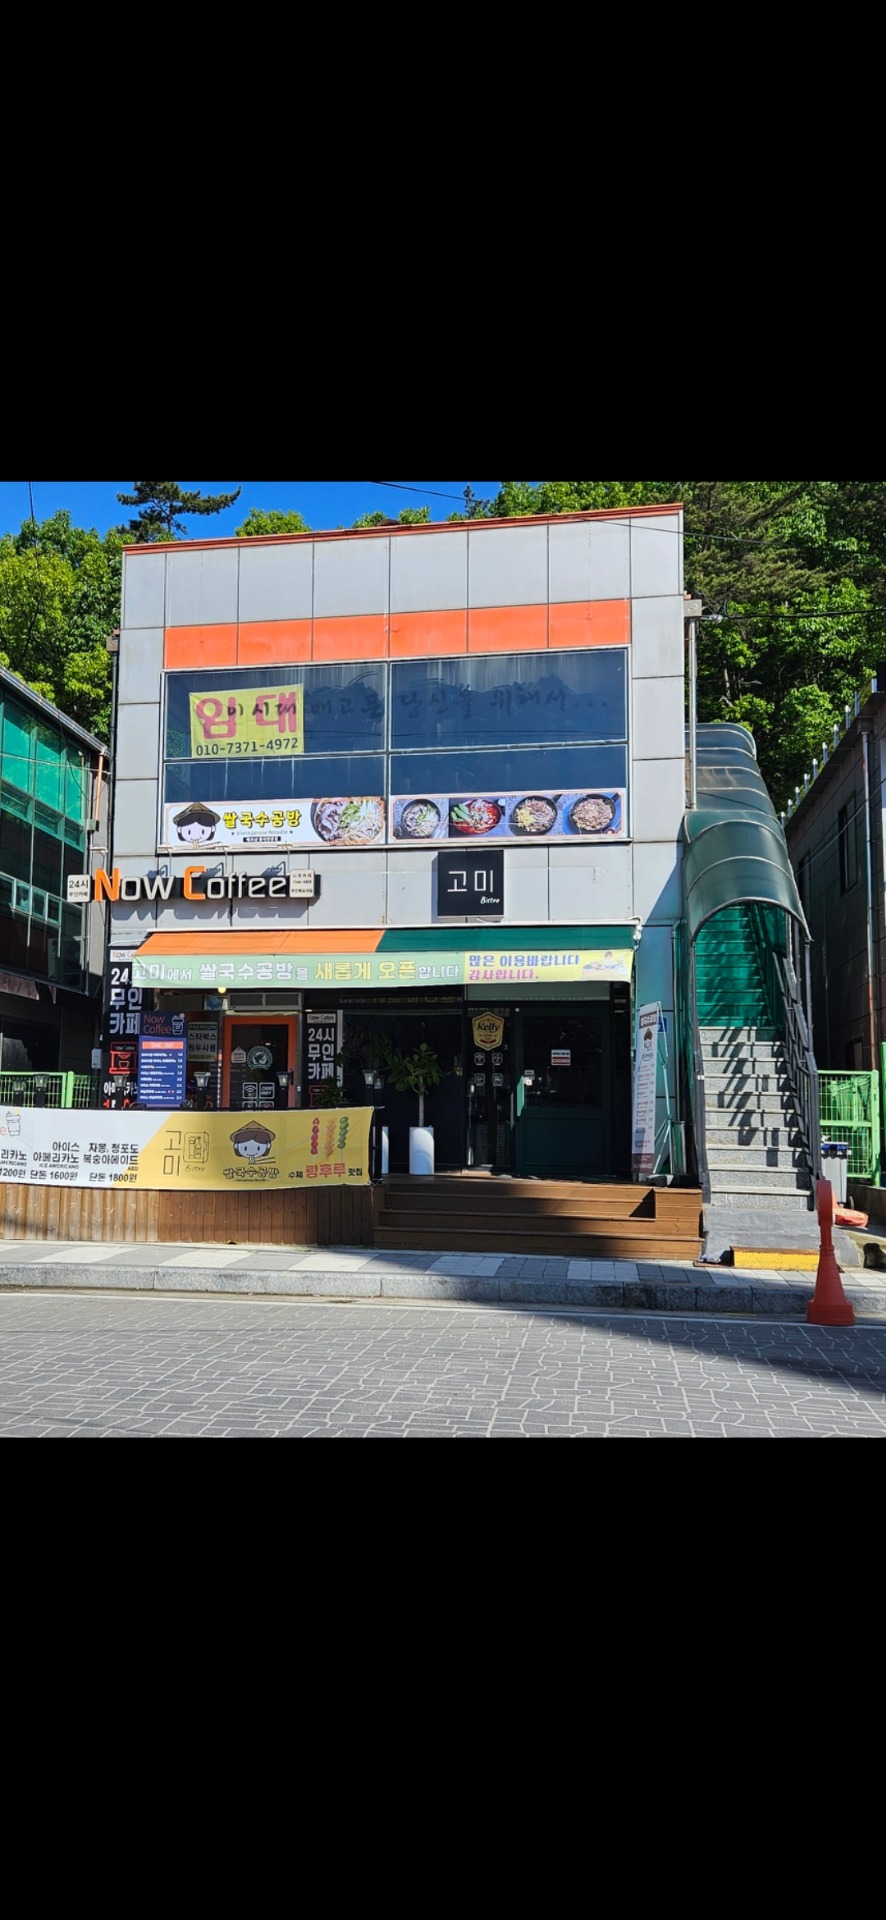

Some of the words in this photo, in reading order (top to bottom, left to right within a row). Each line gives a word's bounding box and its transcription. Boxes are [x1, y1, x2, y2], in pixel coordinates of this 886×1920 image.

[196, 737, 299, 757] 010-7371-4972
[223, 809, 302, 829] 쌀국수공방
[69, 879, 89, 889] 24시
[183, 865, 287, 901] Coffee
[447, 870, 493, 893] 고미
[469, 955, 495, 968] 많은
[499, 954, 580, 968] 이용바랍니다
[133, 962, 193, 982] 고미에서
[199, 961, 309, 982] 쌀국수공방을
[315, 960, 372, 981] 새롭게
[378, 960, 460, 981] 오픈합니다
[469, 968, 539, 981] 감사합니다.
[109, 988, 142, 1011] 무인
[109, 1012, 141, 1035] 카페
[143, 1014, 166, 1024] Now
[143, 1023, 172, 1035] Coffee
[477, 1022, 500, 1033] Kelly
[188, 1032, 217, 1041] 스타벅스
[308, 1027, 335, 1042] 24시
[307, 1043, 334, 1061] 무인
[307, 1062, 334, 1080] 카페
[52, 1141, 80, 1153] 아이스
[111, 1143, 139, 1154] 청포도
[33, 1152, 79, 1163] 아메리카노
[83, 1154, 139, 1165] 복숭아에이드
[185, 1164, 206, 1173] Bistro
[222, 1166, 280, 1180] 쌀국수공방
[348, 1168, 363, 1177] 맛집
[30, 1169, 48, 1180] 단돈
[50, 1171, 78, 1181] 1600원
[89, 1172, 107, 1182] 단돈
[109, 1173, 137, 1183] 1800원
